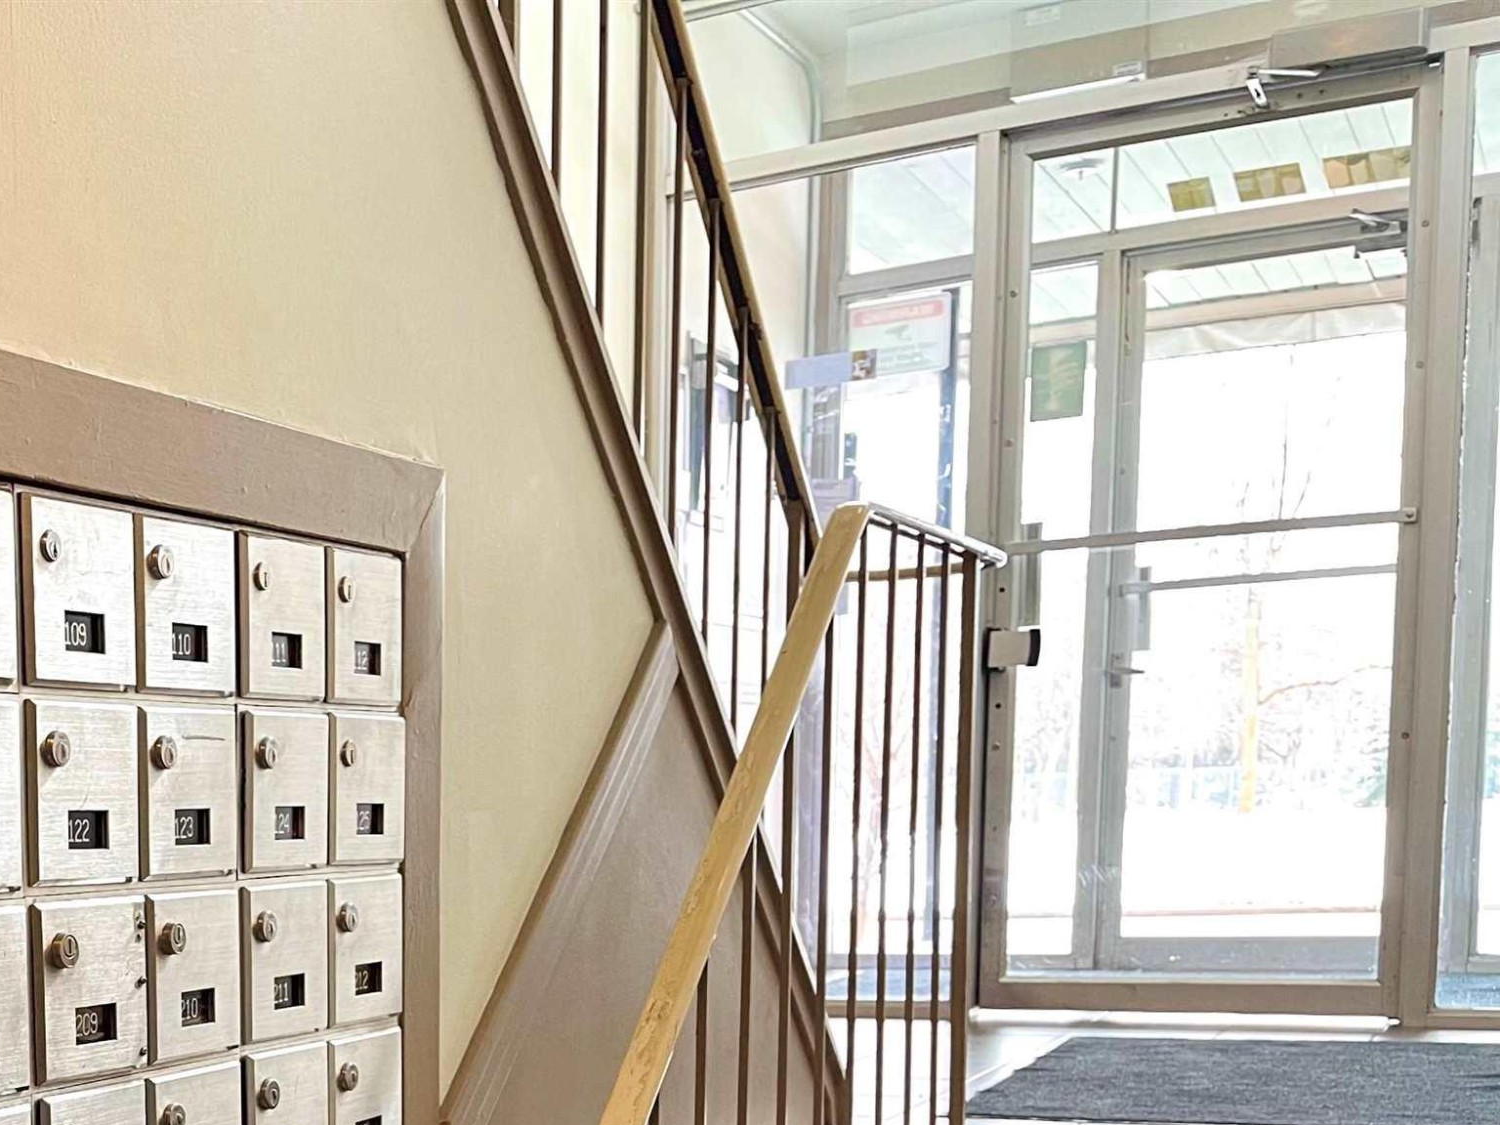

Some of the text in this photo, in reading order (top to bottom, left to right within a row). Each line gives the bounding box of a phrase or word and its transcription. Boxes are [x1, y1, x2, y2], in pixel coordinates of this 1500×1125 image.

[65, 621, 86, 646] 109
[272, 642, 286, 663] 11
[358, 651, 367, 670] 12
[68, 819, 90, 843] 122
[175, 817, 193, 838] 123
[275, 813, 289, 834] 24
[360, 811, 369, 830] 25
[75, 1013, 98, 1036] 209
